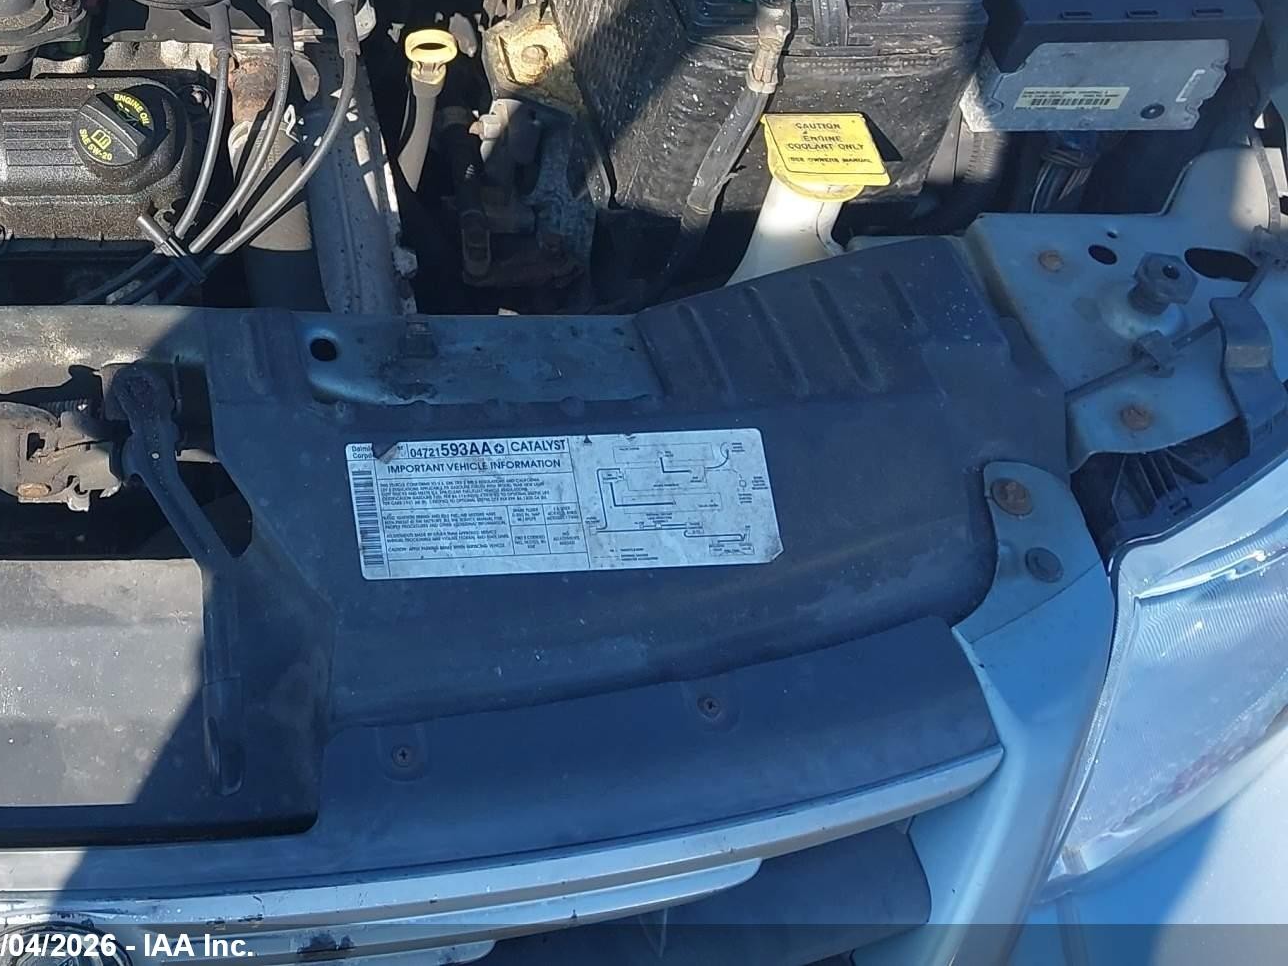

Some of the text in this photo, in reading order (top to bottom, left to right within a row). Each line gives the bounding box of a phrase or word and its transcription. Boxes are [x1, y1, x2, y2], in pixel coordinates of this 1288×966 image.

[114, 94, 150, 126] ENGINE OIL
[80, 129, 112, 160] SAE 5W-20
[410, 442, 492, 458] 04721593AA
[511, 440, 565, 452] CATALYST
[388, 459, 560, 473] IMPORTANT VEHICLE INFORMATION
